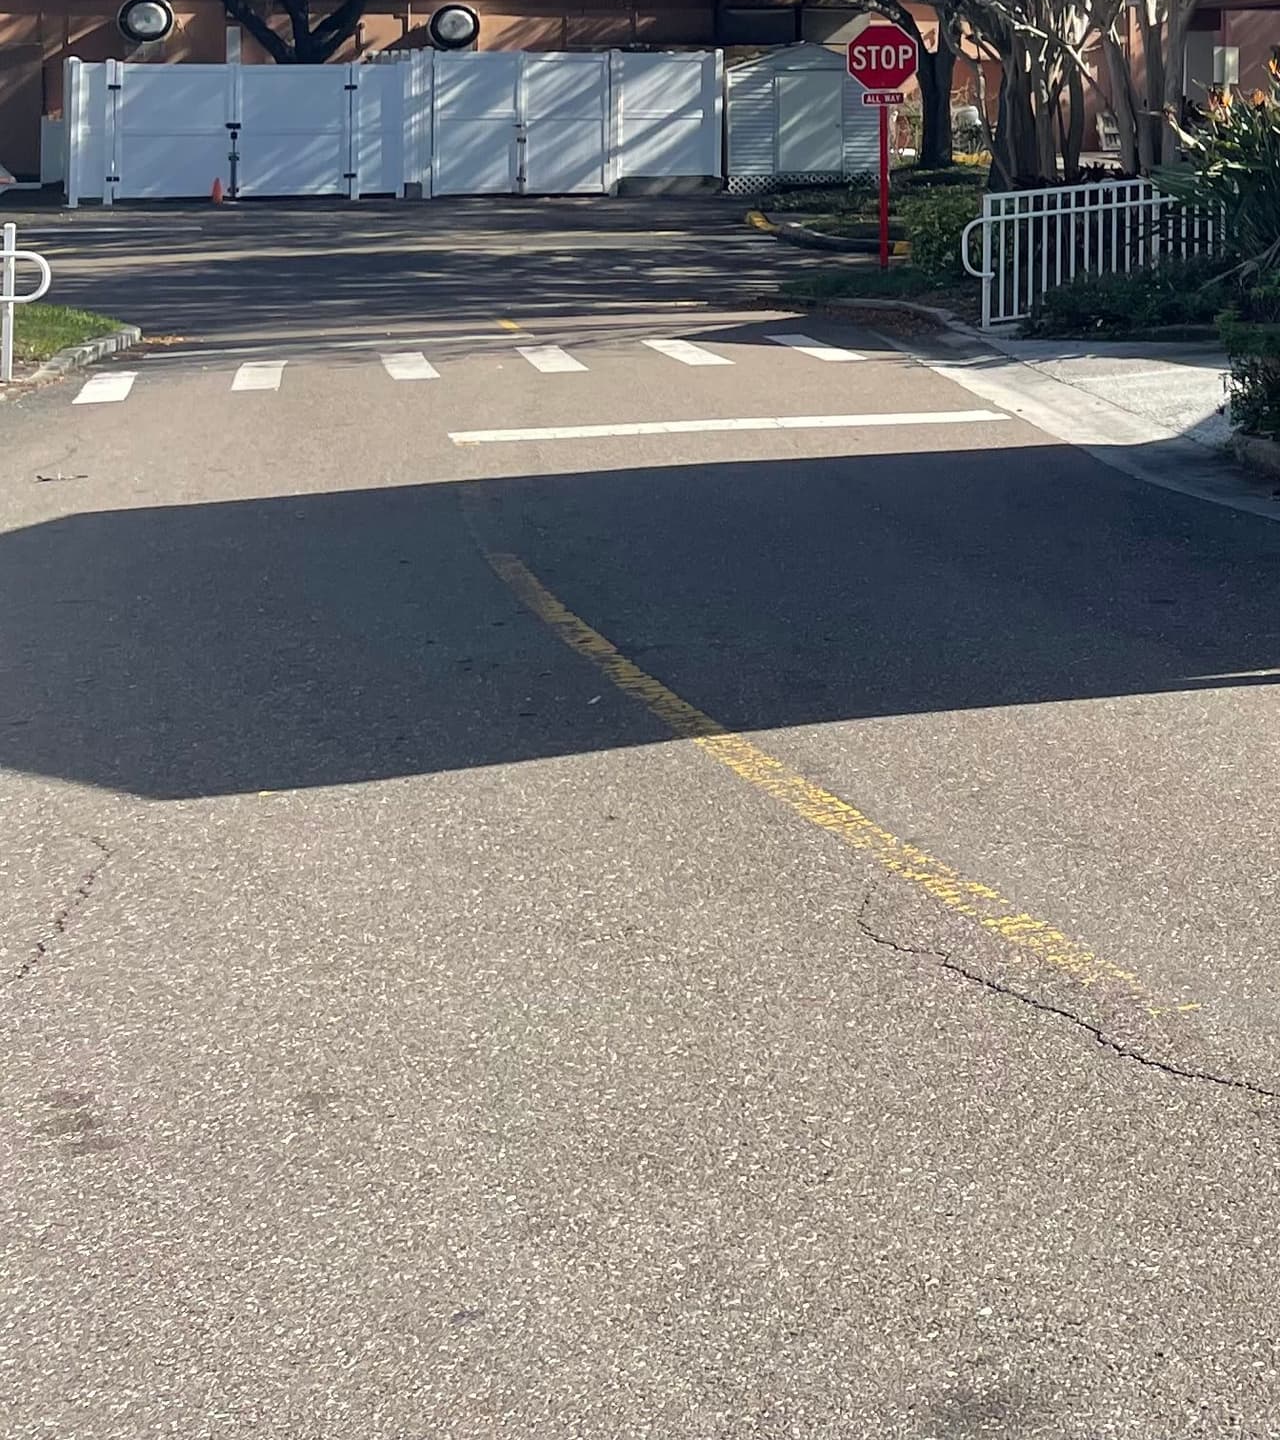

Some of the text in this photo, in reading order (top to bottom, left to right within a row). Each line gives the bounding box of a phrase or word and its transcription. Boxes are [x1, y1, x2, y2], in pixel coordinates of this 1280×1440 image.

[852, 45, 913, 70] STOP
[866, 94, 901, 103] ALL WAY
